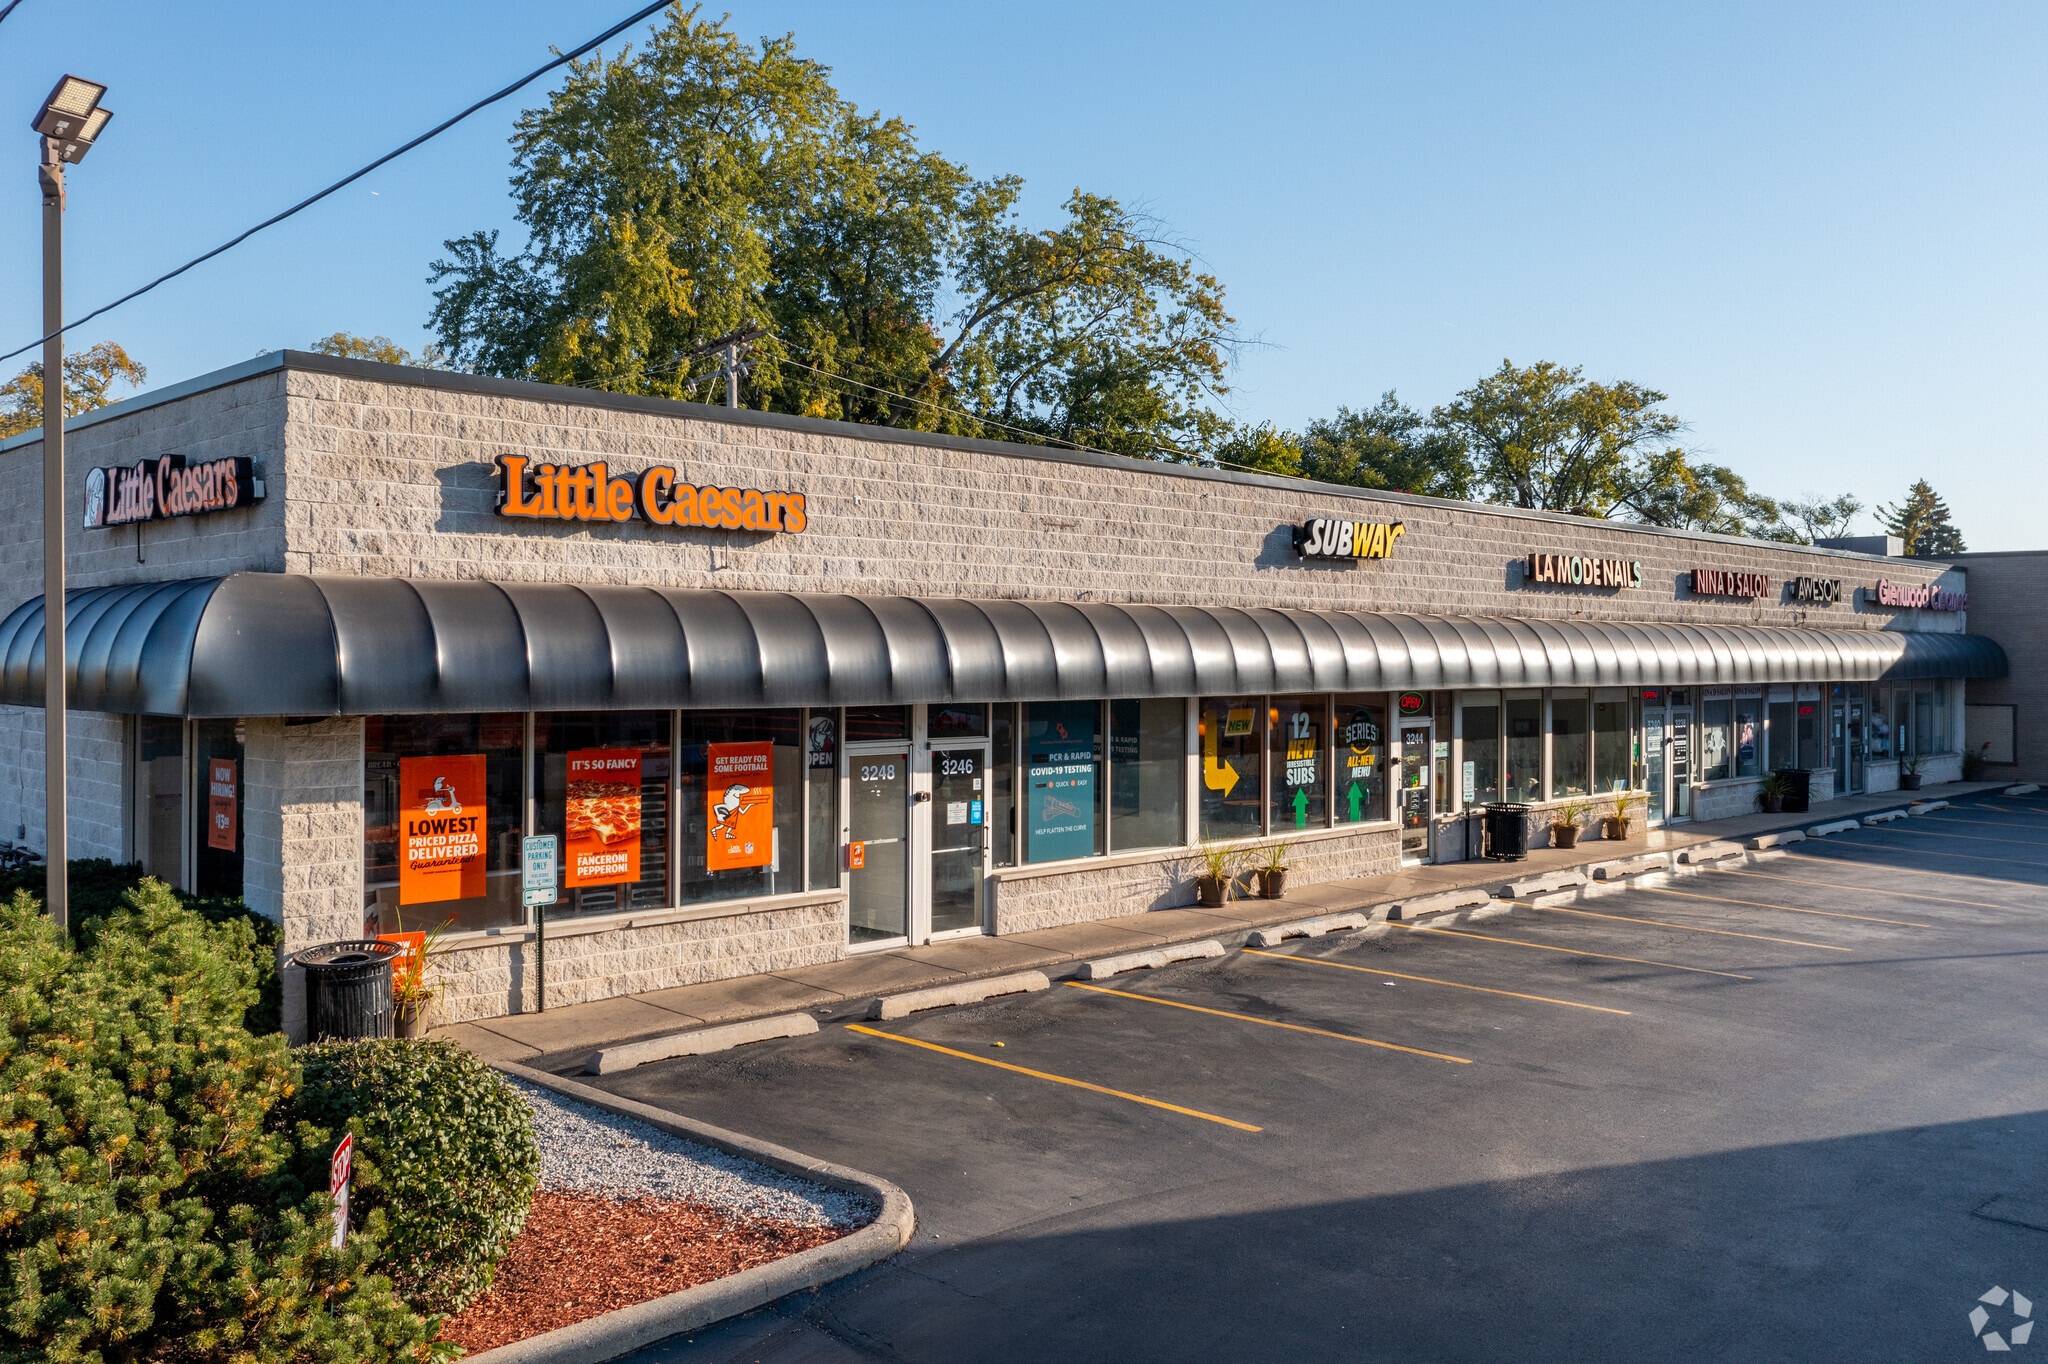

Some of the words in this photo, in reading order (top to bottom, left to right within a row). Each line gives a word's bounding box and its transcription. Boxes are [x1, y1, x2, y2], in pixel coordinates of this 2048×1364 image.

[107, 460, 154, 524] Little
[157, 453, 238, 516] Caesars
[500, 454, 634, 522] Little
[641, 464, 806, 534] Caesars
[1303, 518, 1406, 558] SUBWAY
[1534, 552, 1555, 583] LA
[1557, 554, 1601, 586] MODE
[1602, 559, 1642, 589] NAILS
[1696, 568, 1725, 595] NINA
[1727, 571, 1735, 595] D
[1736, 572, 1770, 598] SALON
[1798, 576, 1842, 602] AWESOM
[1878, 578, 1930, 608] Glenwood
[1930, 585, 1969, 611] Cleaners
[1401, 696, 1421, 709] OPEN
[1228, 719, 1250, 731] NEW
[1292, 712, 1310, 739] 12
[1346, 722, 1376, 744] SERIES
[1406, 733, 1423, 744] 3244
[1049, 753, 1063, 762] PCR
[1070, 751, 1091, 760] RAPID
[1287, 739, 1316, 760] NEW
[572, 760, 590, 771] IT'S
[592, 759, 605, 770] SO
[606, 758, 637, 769] FANCY
[715, 756, 729, 765] GET
[729, 755, 753, 764] READY
[753, 754, 768, 763] FOR
[808, 752, 833, 766] OPEN
[941, 758, 974, 775] 3246
[1287, 759, 1315, 768] IRRESISTIBLE
[1347, 754, 1376, 767] ALL-NEW
[215, 767, 231, 782] NOW
[713, 765, 734, 773] SOME
[734, 763, 768, 772] FOOTBALL
[861, 764, 895, 782] 3248
[1031, 767, 1063, 776] COVID-19
[1064, 764, 1092, 774] TESTING
[1351, 766, 1371, 778] MENU
[1286, 767, 1315, 786] SUBS
[211, 781, 235, 798] HIRING!
[408, 816, 478, 837] LOWEST
[1073, 824, 1087, 832] CURVE
[408, 835, 447, 848] PRICED
[448, 833, 478, 845] PIZZA
[526, 840, 554, 851] CUSTOMER
[408, 843, 479, 861] DELIVERED
[527, 851, 552, 861] PARKING
[410, 853, 475, 871] Guaranteed!
[533, 861, 547, 870] ONLY
[577, 853, 628, 867] FANCERONI
[577, 863, 628, 877] PEPPERONI
[332, 1146, 351, 1195] STOP
